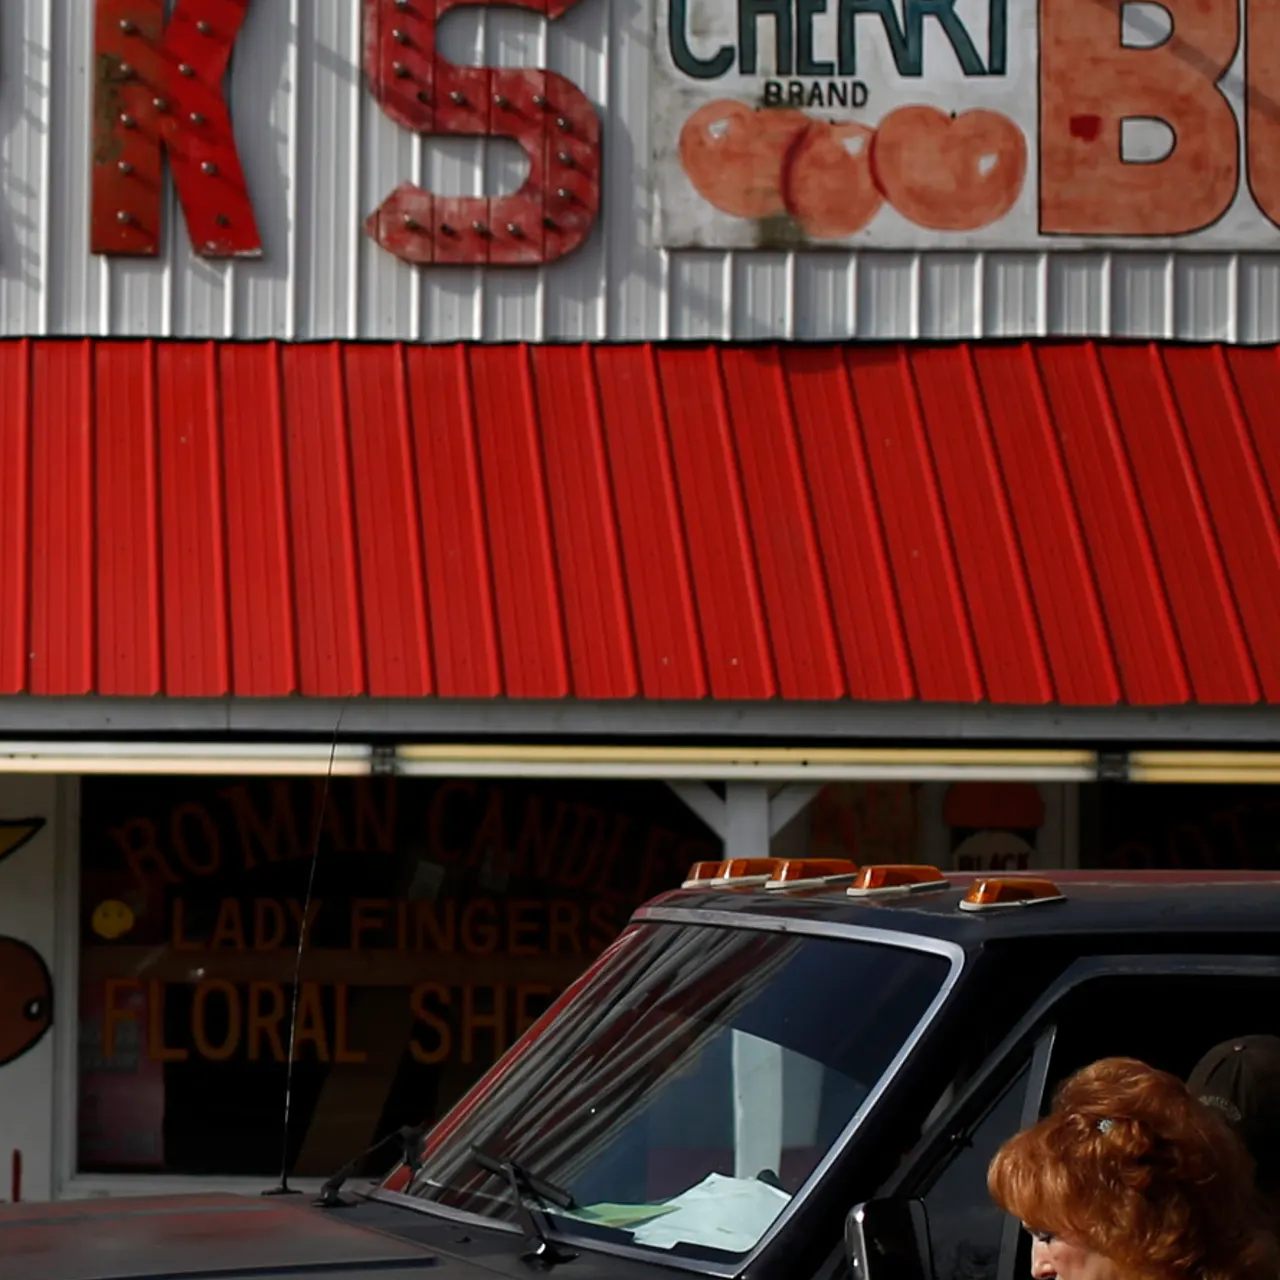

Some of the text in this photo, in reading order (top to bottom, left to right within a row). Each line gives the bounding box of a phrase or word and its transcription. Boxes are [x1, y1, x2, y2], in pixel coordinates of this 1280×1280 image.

[763, 80, 869, 109] BRAND
[106, 776, 397, 892] ROMAN
[170, 895, 620, 956] LADY FINGERS
[100, 978, 370, 1064] FLORAL
